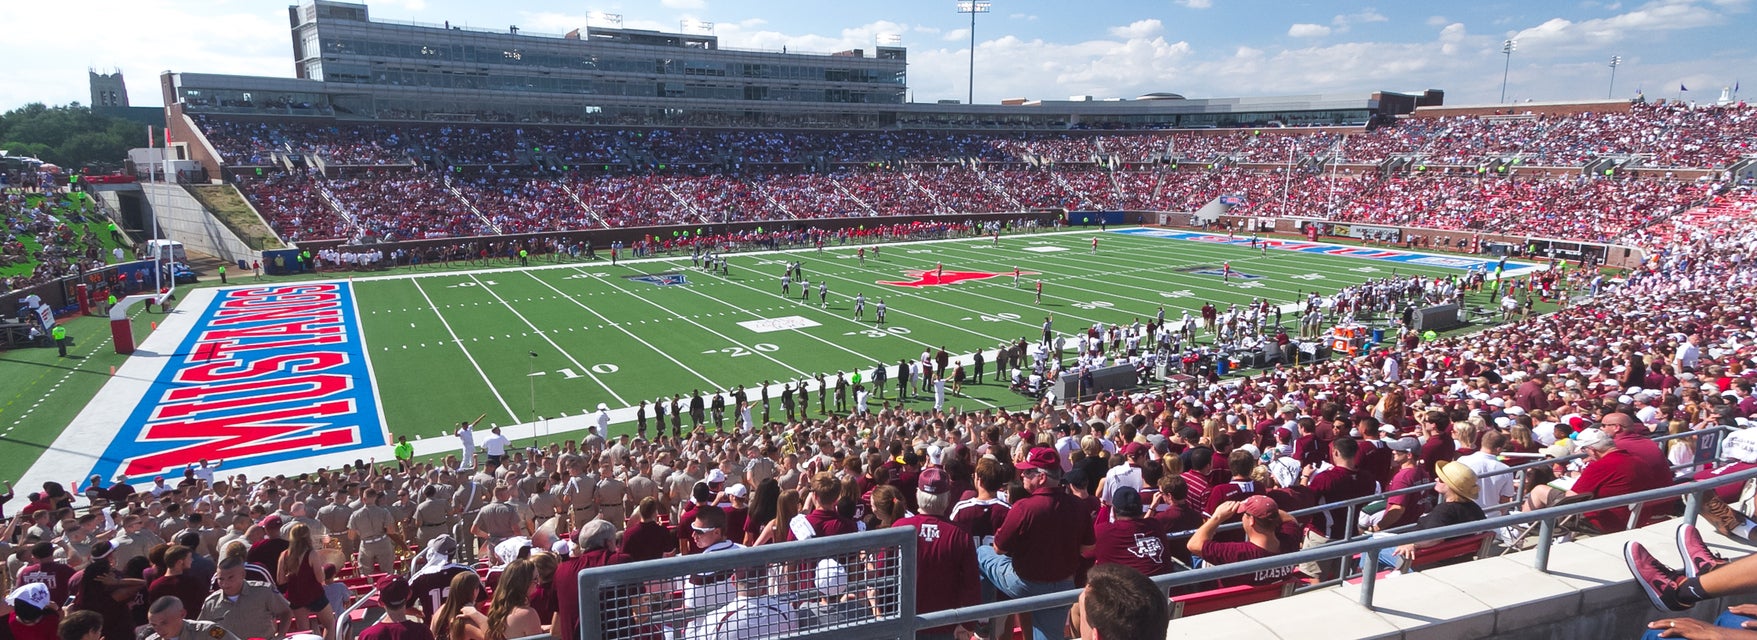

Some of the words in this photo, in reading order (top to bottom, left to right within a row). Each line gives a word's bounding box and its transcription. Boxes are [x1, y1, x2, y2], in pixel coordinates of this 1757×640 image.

[858, 326, 912, 338] 30
[720, 343, 781, 358] 20
[1335, 340, 1344, 349] G
[555, 363, 620, 380] 10
[110, 283, 362, 483] MUSTANGS
[1700, 433, 1715, 450] 127
[1254, 567, 1281, 581] TEXAS
